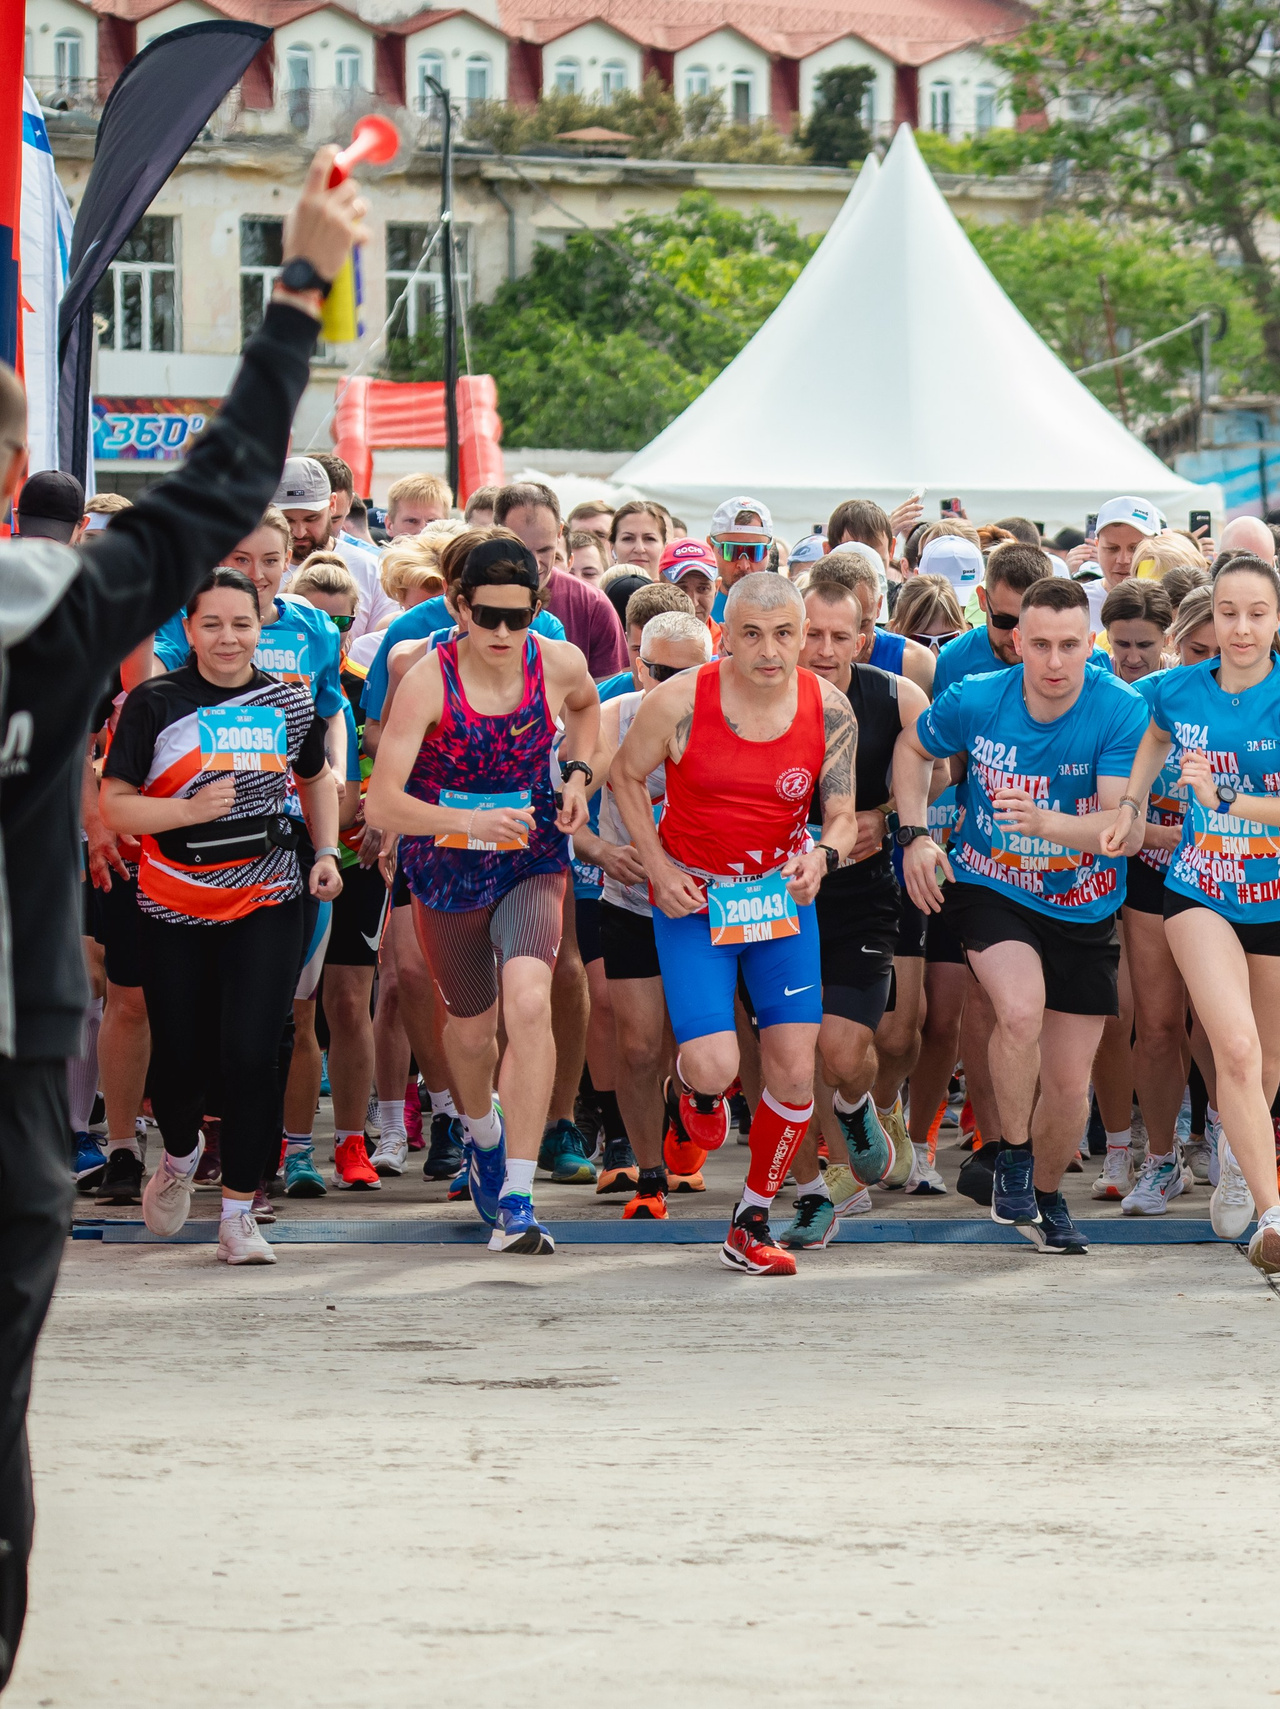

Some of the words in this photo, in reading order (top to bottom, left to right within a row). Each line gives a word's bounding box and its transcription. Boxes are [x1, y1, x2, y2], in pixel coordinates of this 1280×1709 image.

[675, 546, 704, 556] SOCHI
[251, 648, 296, 671] 0056
[216, 727, 274, 751] 20035
[1174, 721, 1209, 748] 2024
[233, 752, 262, 770] 5KM
[971, 735, 1018, 773] 2024
[926, 804, 956, 826] 067
[1208, 809, 1263, 835] 20075
[1222, 836, 1250, 855] 5KM
[1020, 855, 1050, 871] 5KM
[732, 873, 763, 883] TITAN
[726, 893, 784, 924] 20043
[743, 921, 773, 943] 5KM
